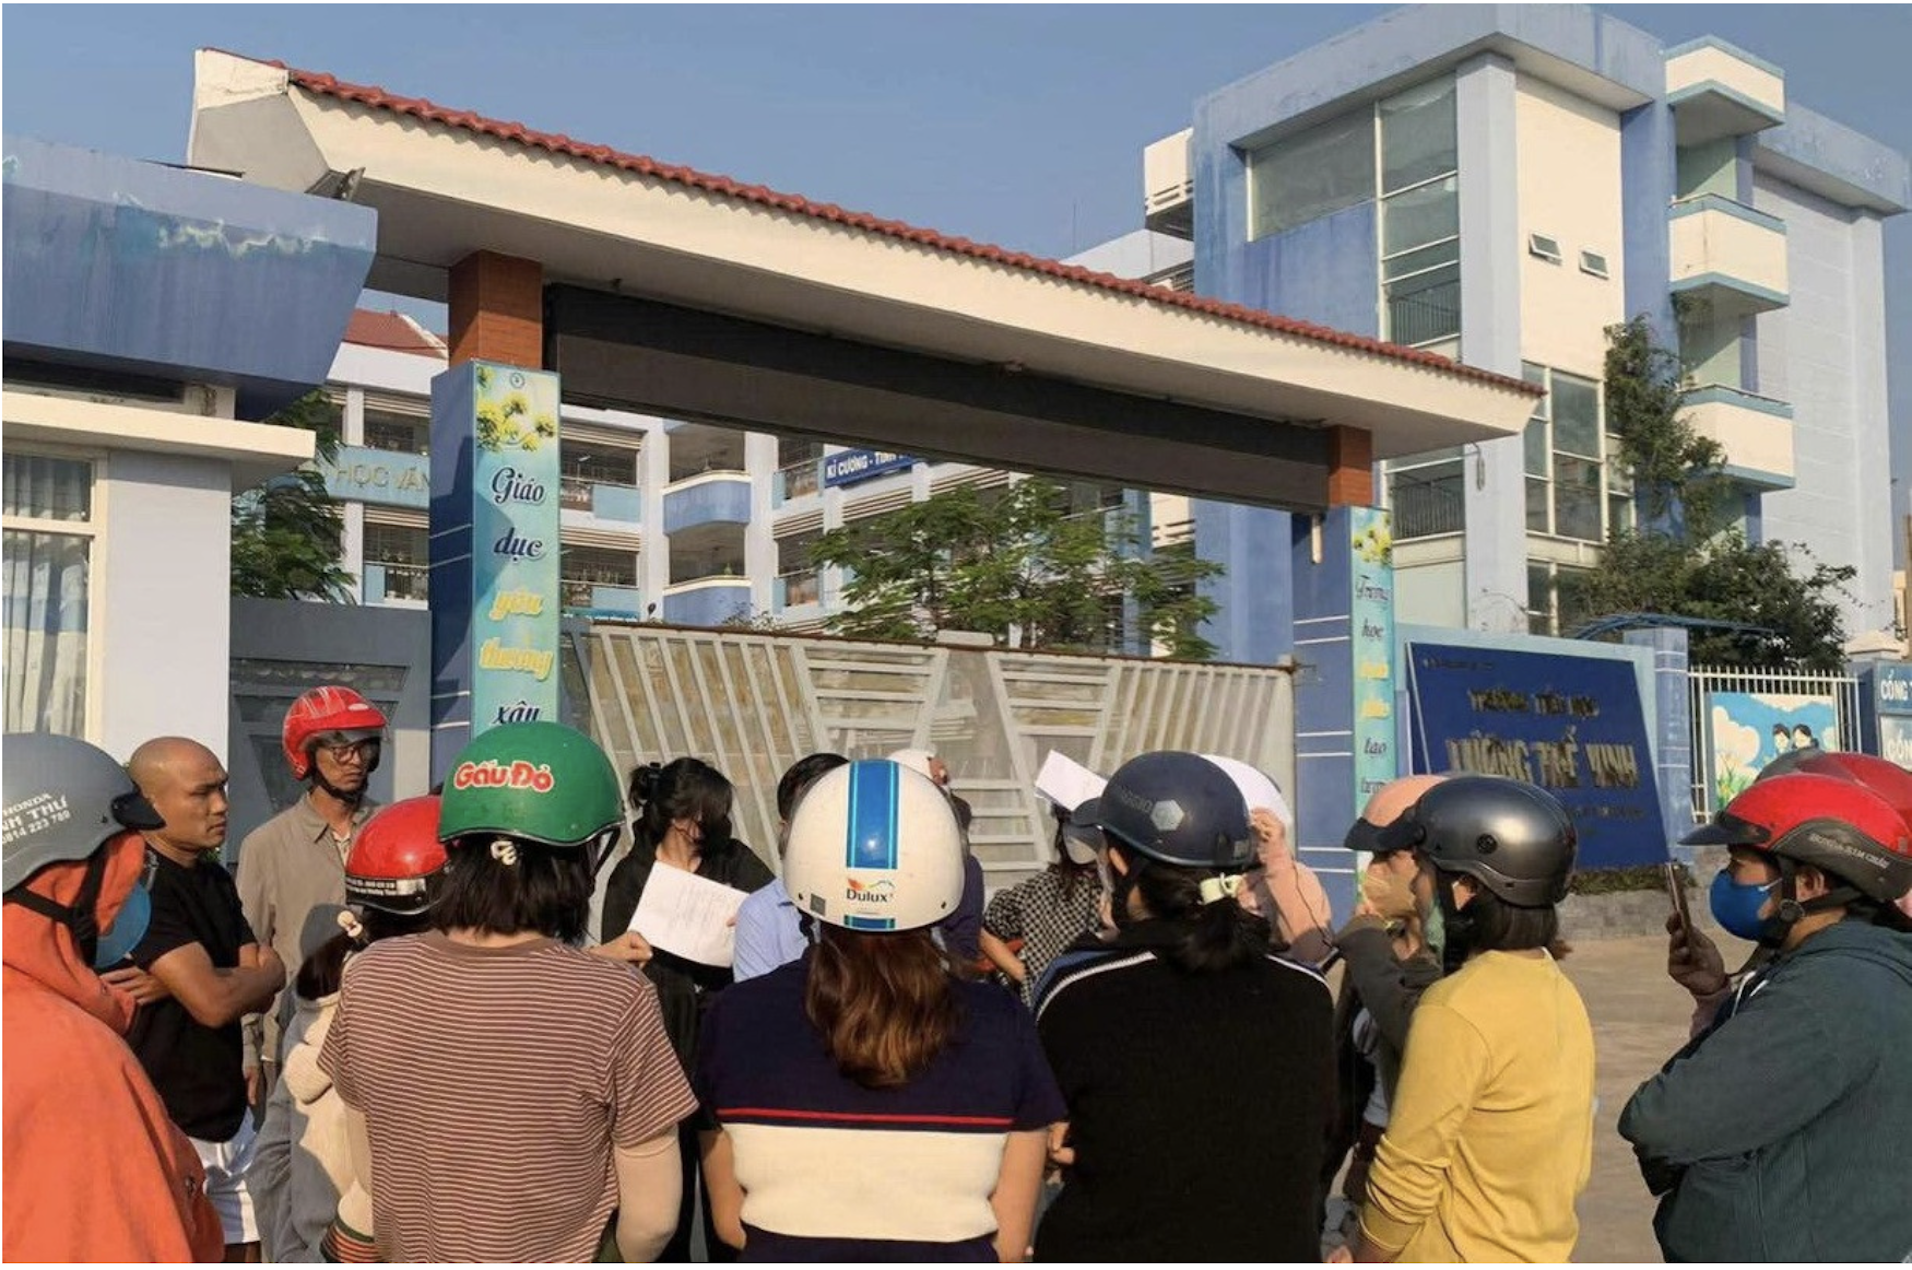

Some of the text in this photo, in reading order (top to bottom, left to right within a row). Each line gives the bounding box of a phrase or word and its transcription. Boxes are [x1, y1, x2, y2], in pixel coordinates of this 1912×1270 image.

[491, 466, 545, 504] Giáo
[493, 526, 543, 562] dục
[453, 758, 554, 793] Gấu Đỏ
[846, 887, 888, 902] Dulux
